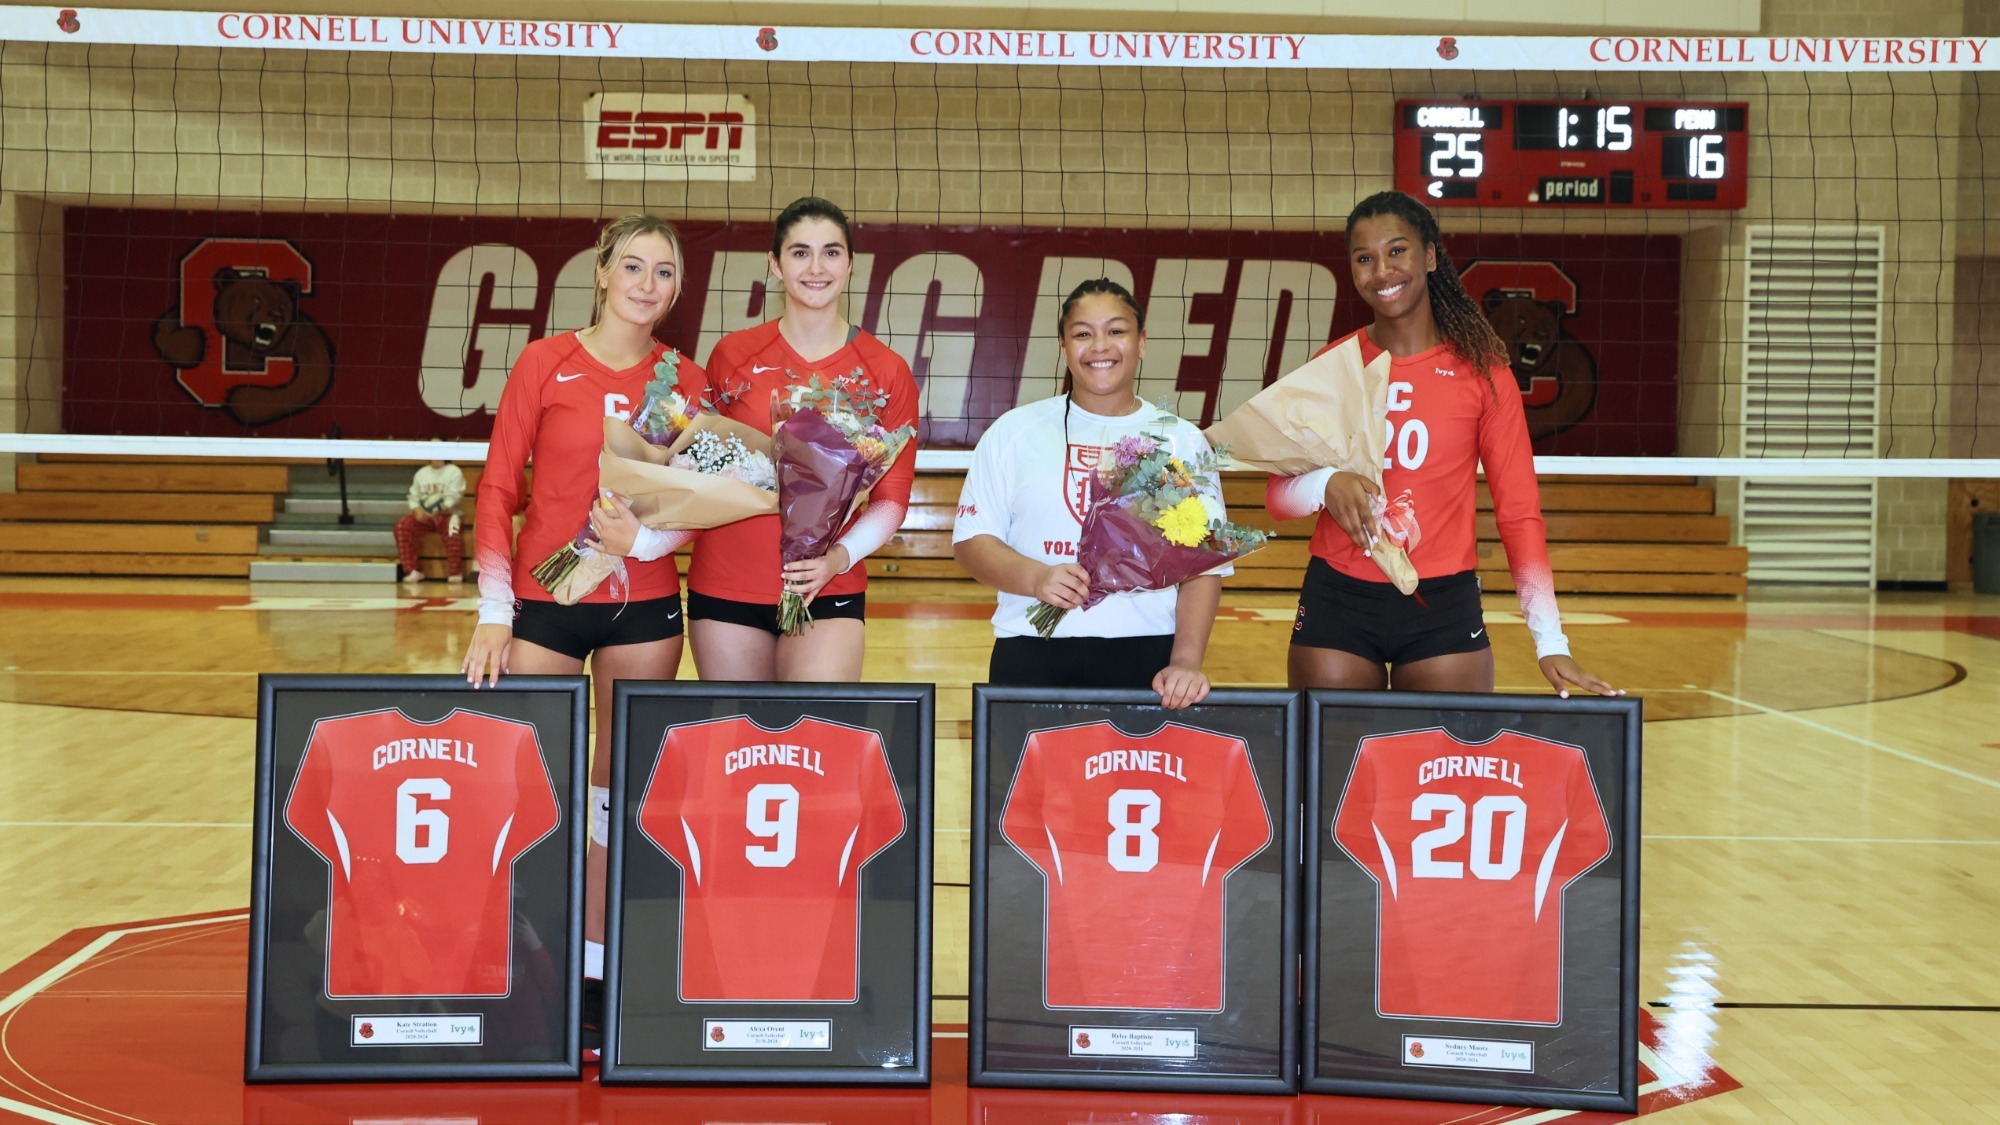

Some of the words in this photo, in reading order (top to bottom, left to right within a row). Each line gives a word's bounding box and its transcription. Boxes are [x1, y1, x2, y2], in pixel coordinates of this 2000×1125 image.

[217, 14, 388, 43] CORNELL
[401, 19, 623, 48] UNIVERSITY
[910, 30, 1075, 58] CORNELL
[1088, 33, 1306, 60] UNIVERSITY
[1590, 38, 1754, 63] CORNELL
[1769, 38, 1988, 64] UNIVERSITY
[596, 111, 744, 150] ESPN
[1417, 107, 1485, 128] CORNELL
[1558, 106, 1632, 150] 1:15
[595, 153, 609, 162] THE
[613, 153, 661, 162] WORLDWIDE
[664, 154, 695, 162] LEADER
[698, 155, 706, 163] IN
[709, 155, 740, 163] SPORTS
[1430, 133, 1483, 177] 25
[1688, 135, 1725, 179] 16
[1545, 178, 1598, 200] period
[604, 393, 630, 421] C
[1387, 382, 1413, 411] C
[373, 738, 477, 770] CORNELL
[725, 744, 824, 776] CORNELL
[1085, 750, 1187, 782] CORNELL
[1419, 756, 1524, 789] CORNELL
[395, 778, 451, 864] 6
[745, 784, 799, 867] 9
[1107, 788, 1161, 872] 8
[1410, 793, 1527, 880] 20
[451, 1024, 466, 1035] Ivy
[799, 1029, 815, 1040] Ivy
[1165, 1037, 1181, 1048] Ivy
[1501, 1049, 1517, 1061] Ivy
